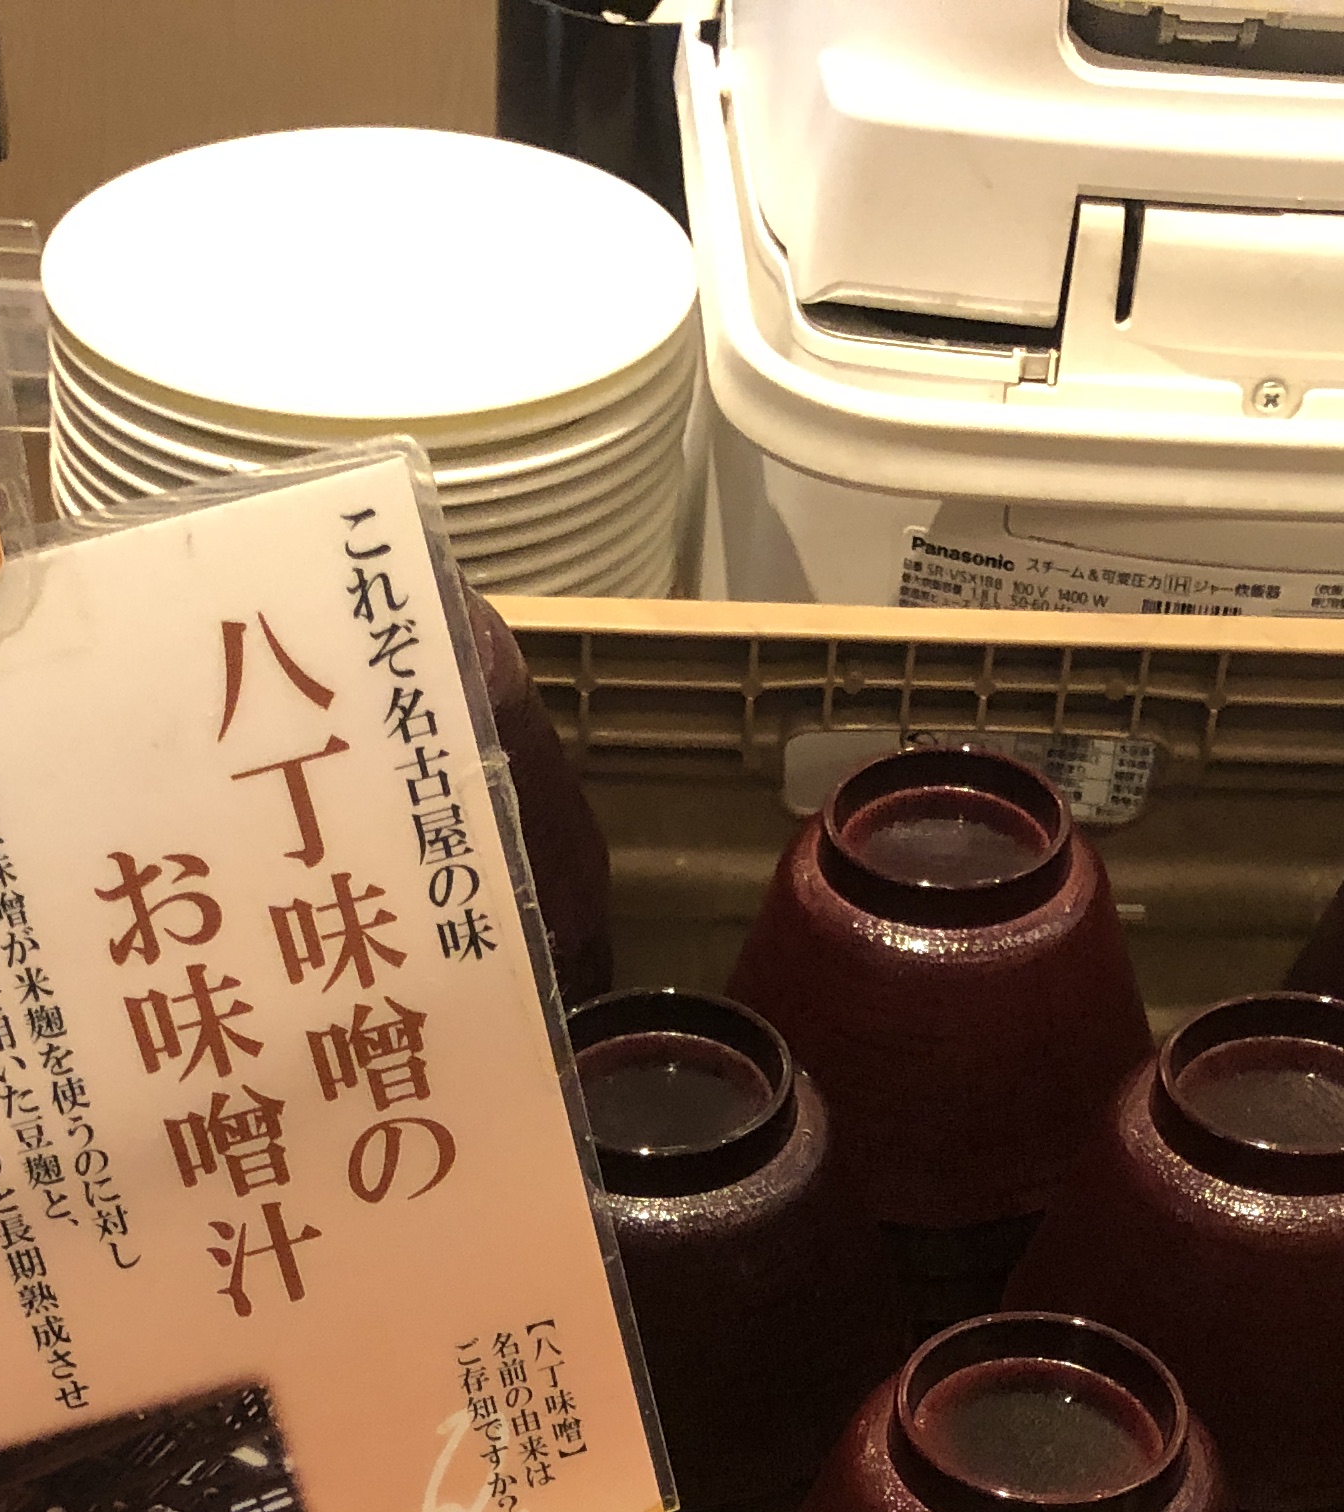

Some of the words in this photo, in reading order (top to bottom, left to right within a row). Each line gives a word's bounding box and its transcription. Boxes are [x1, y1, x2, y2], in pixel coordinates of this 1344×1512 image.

[912, 536, 1015, 572] Panasonic
[341, 508, 499, 962] これぞ名古屋の味
[217, 610, 458, 1204] 八丁味噌の
[94, 851, 323, 1317] お味噌汁
[491, 1332, 556, 1489] 名前の由来は
[525, 1319, 588, 1459] 【八丁味噌】
